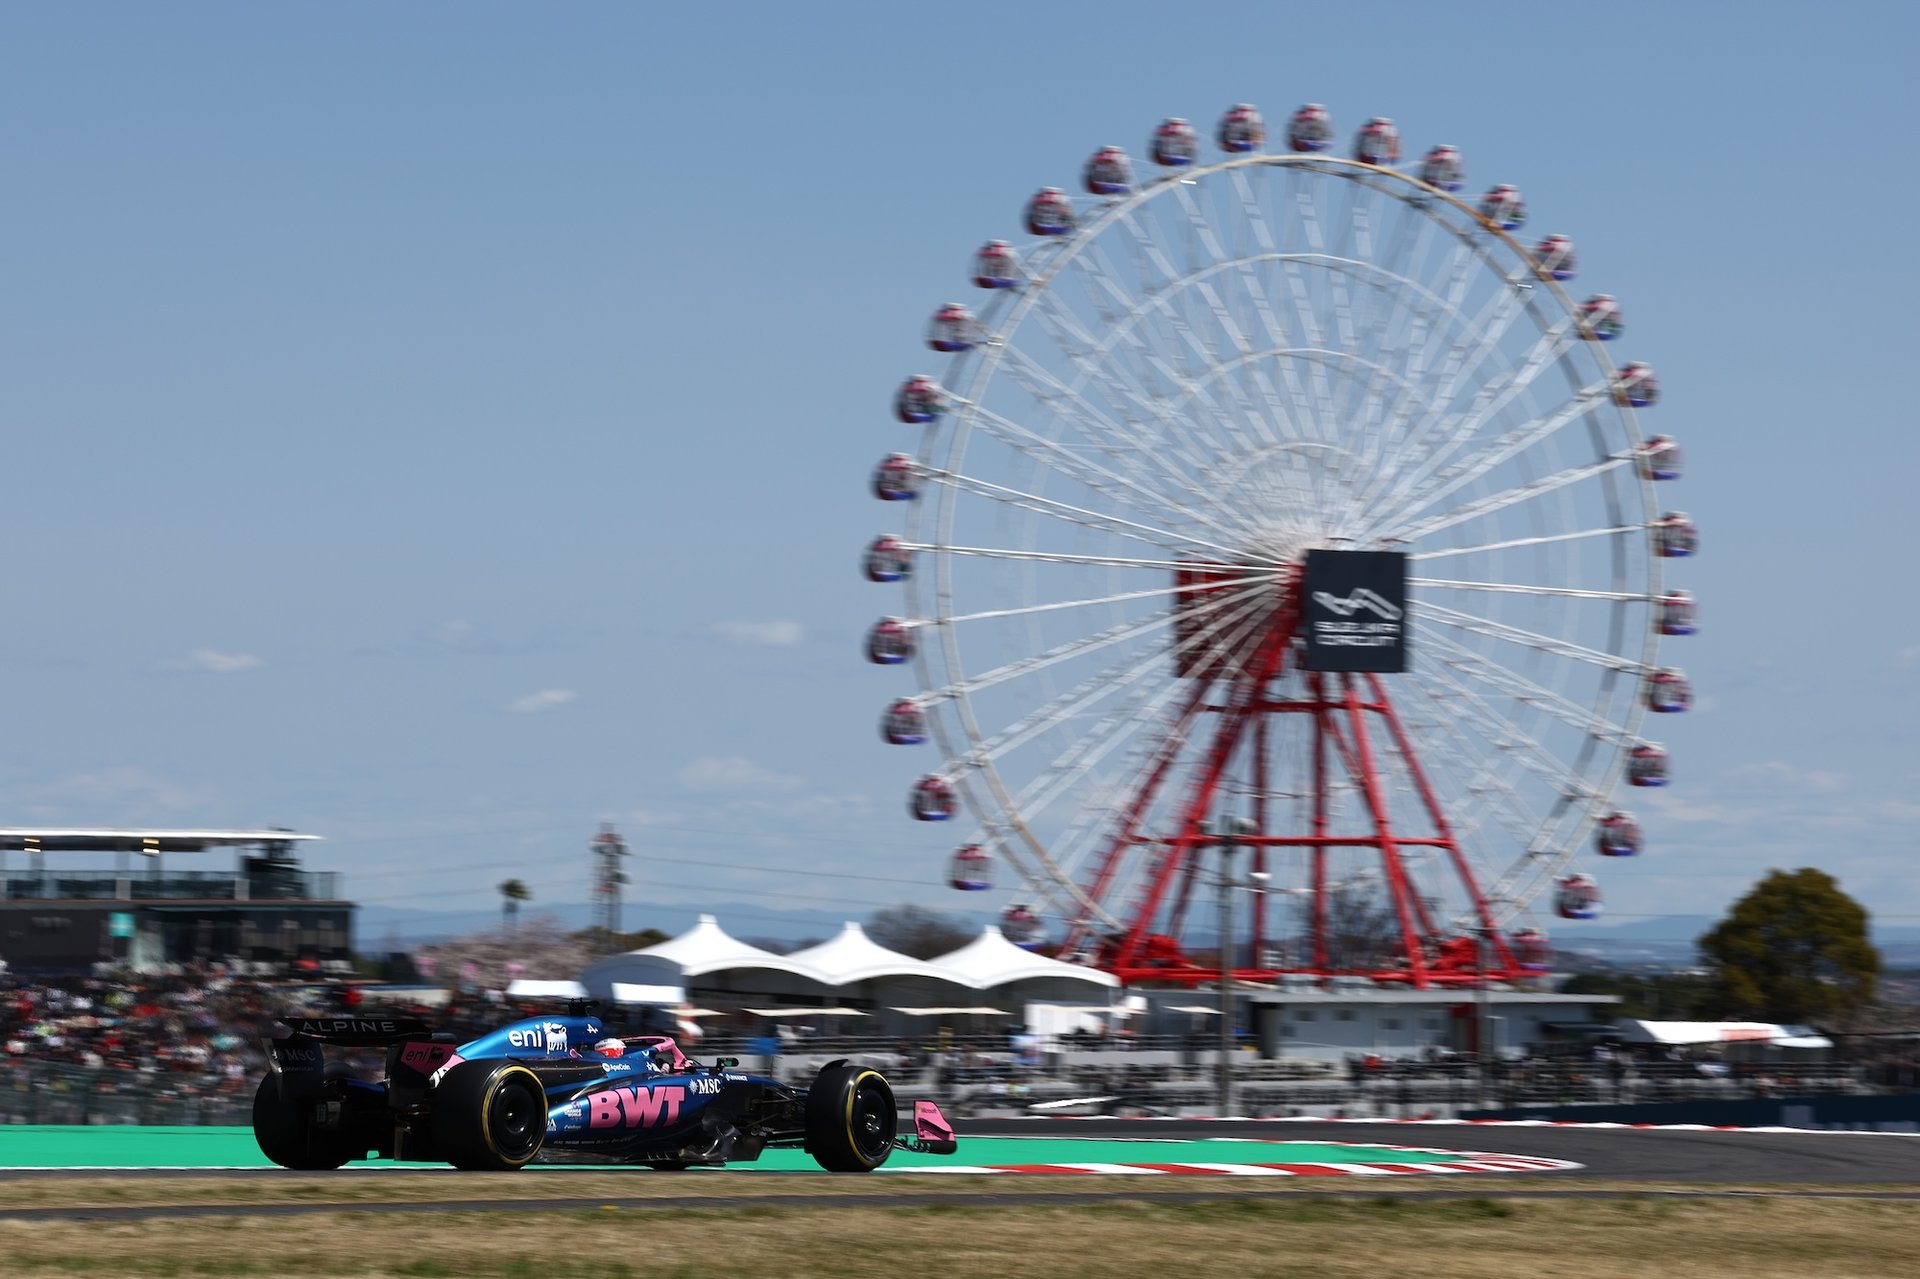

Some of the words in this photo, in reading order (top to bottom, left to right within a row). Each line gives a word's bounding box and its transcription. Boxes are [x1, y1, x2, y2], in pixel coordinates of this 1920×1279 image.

[302, 1020, 397, 1033] ALPINE
[508, 1024, 542, 1048] eni
[285, 1049, 316, 1062] MSC
[405, 1048, 429, 1062] eni
[698, 1078, 721, 1095] MSC
[587, 1086, 685, 1129] BWT
